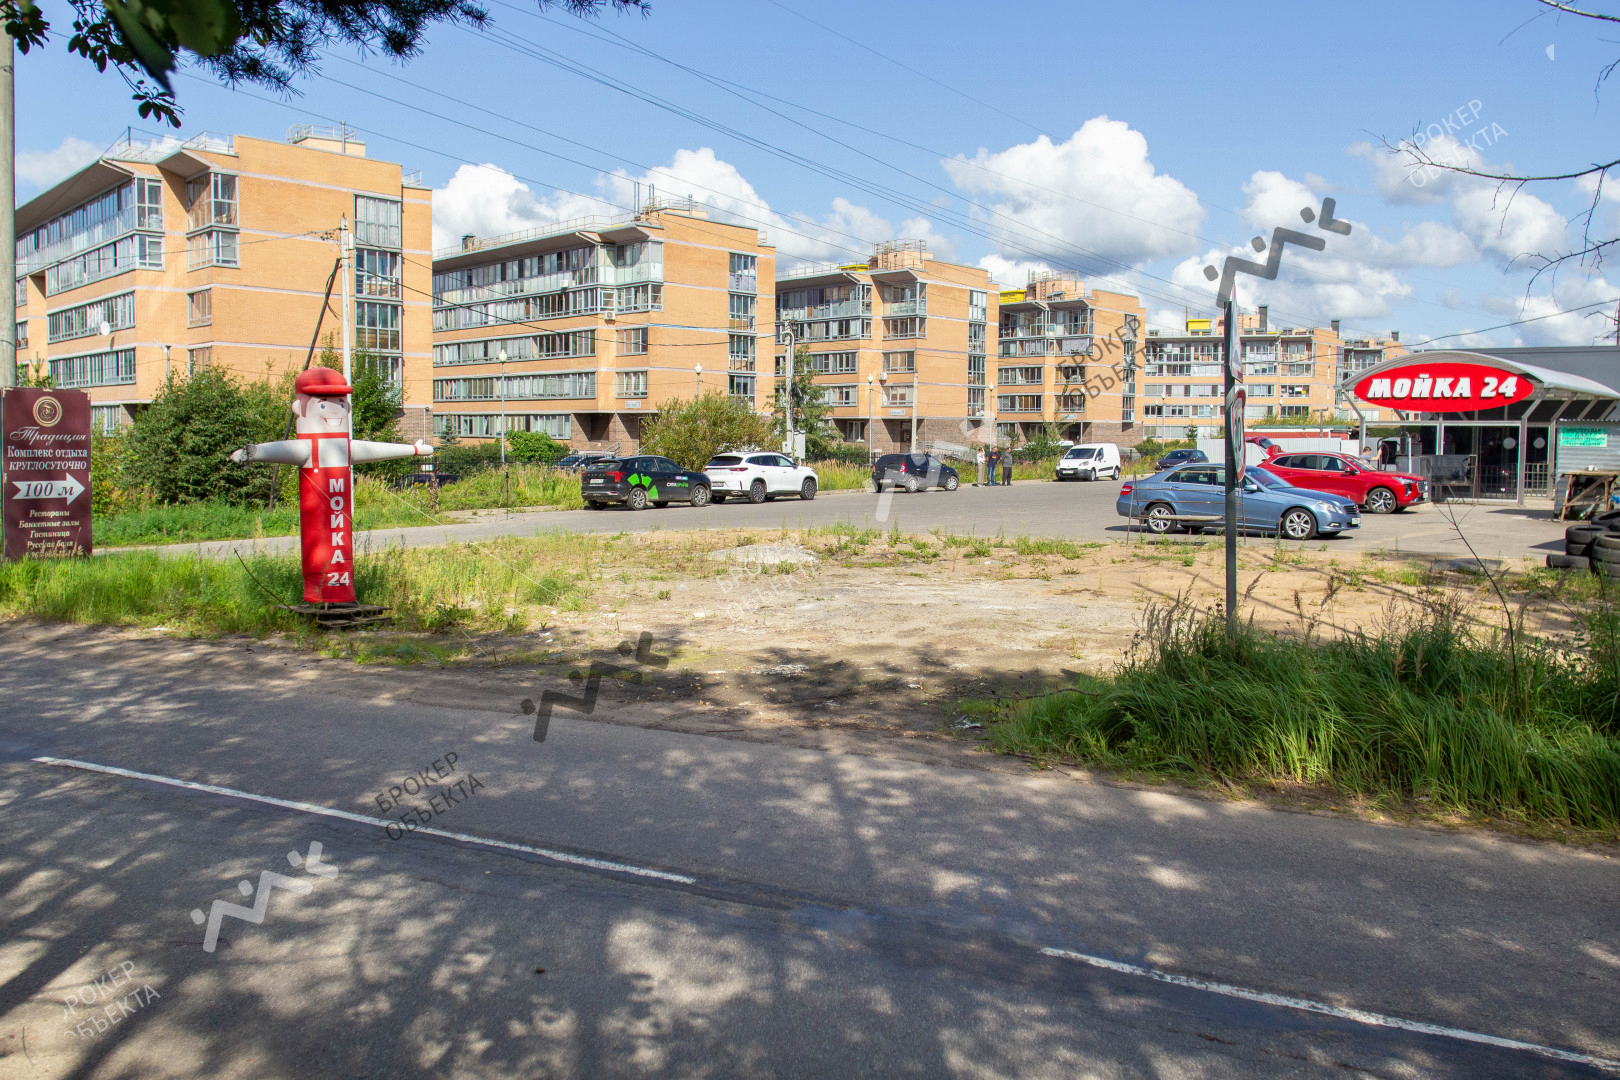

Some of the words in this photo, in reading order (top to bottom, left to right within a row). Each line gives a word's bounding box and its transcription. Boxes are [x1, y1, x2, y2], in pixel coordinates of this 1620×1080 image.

[1366, 373, 1472, 399] МОЙКА
[1479, 376, 1519, 399] 24
[9, 426, 87, 446] Традиция
[7, 445, 54, 458] Комплекс
[55, 448, 88, 459] отдыха
[9, 460, 88, 471] КРУГЛОСУТОЧНО
[23, 482, 54, 498] 100
[29, 509, 71, 518] Рестораны
[18, 520, 61, 529] Банкетные
[328, 478, 346, 565] МОЙКА
[29, 530, 71, 539] Гостиница
[327, 571, 350, 587] 24
